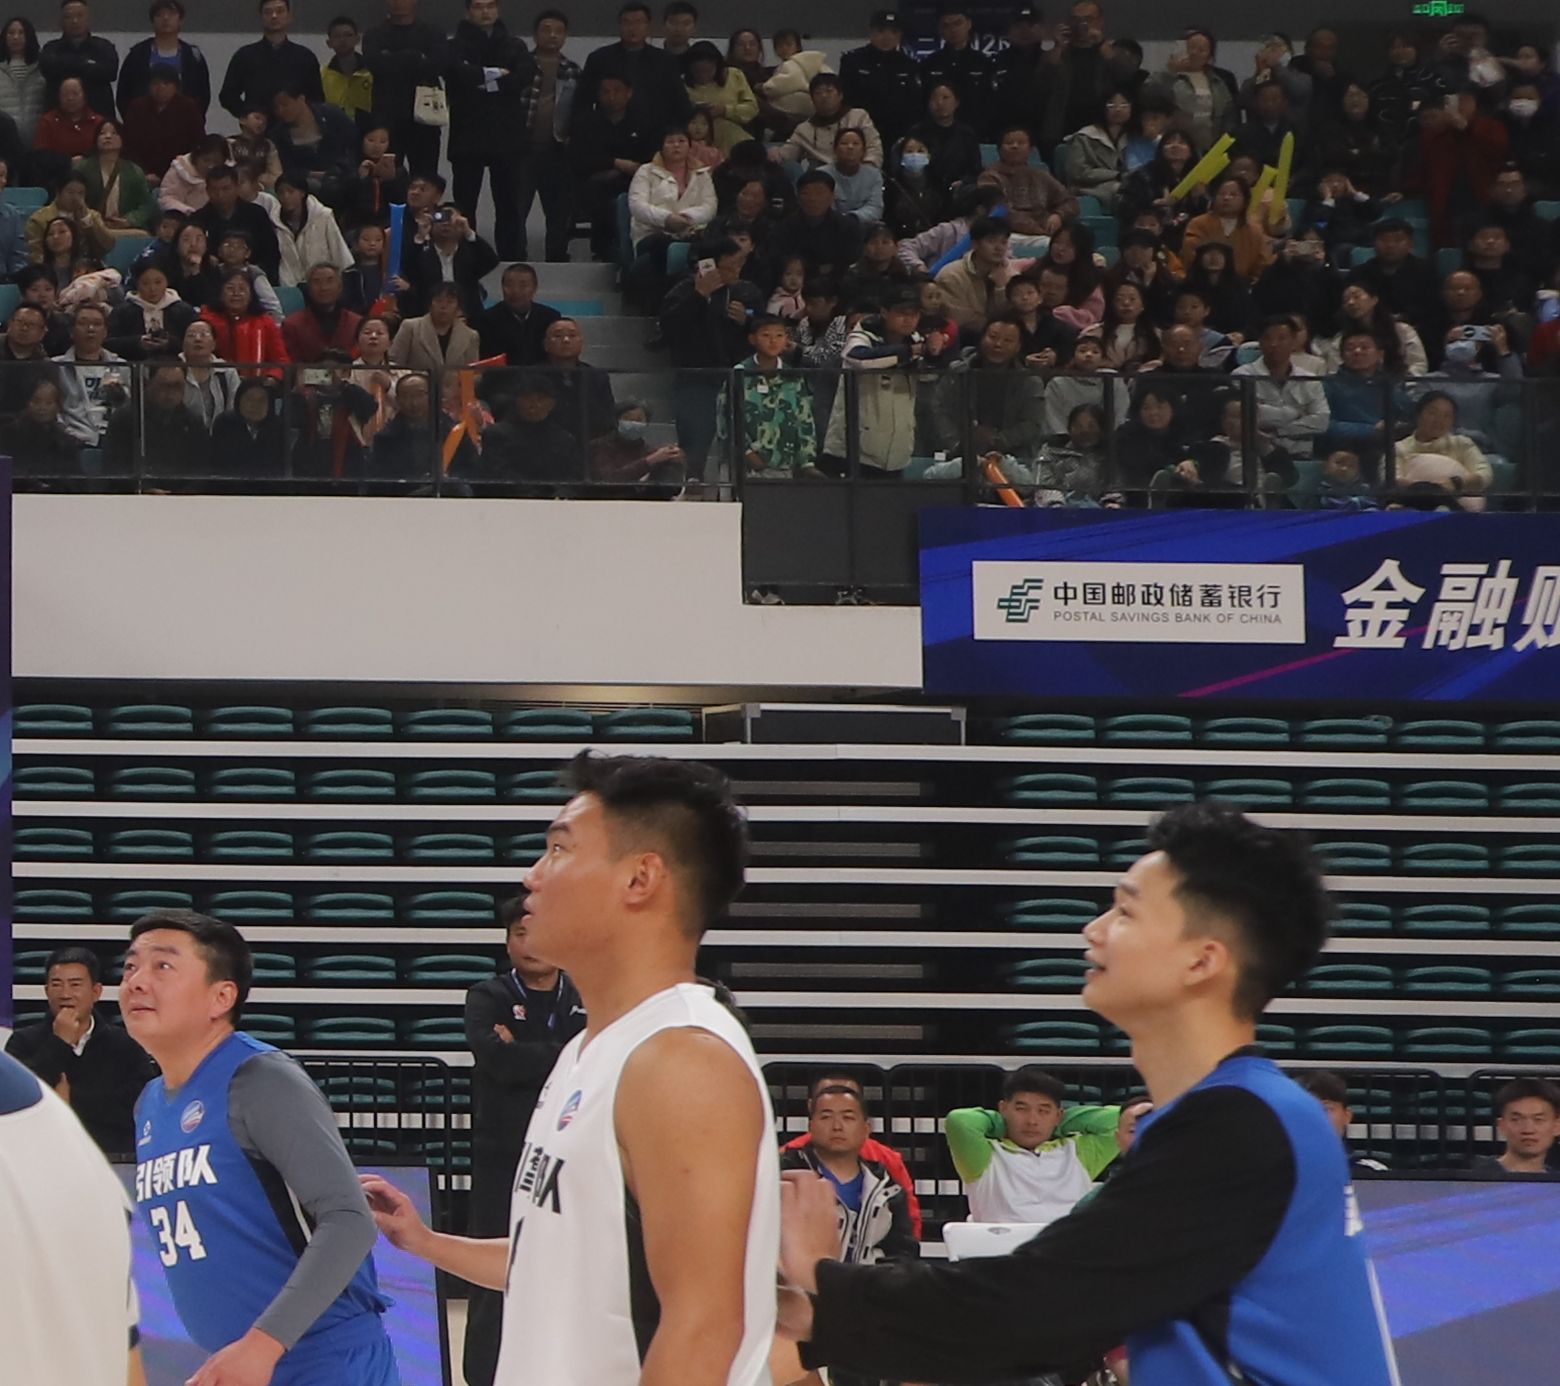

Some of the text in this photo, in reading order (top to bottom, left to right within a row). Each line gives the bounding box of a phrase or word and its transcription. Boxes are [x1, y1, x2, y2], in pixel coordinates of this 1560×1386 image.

[1052, 581, 1283, 609] 中国邮政储蓄银行
[1053, 610, 1282, 625] POSTAL SAVINGS BANK OF CHINA
[150, 1199, 207, 1268] 34
